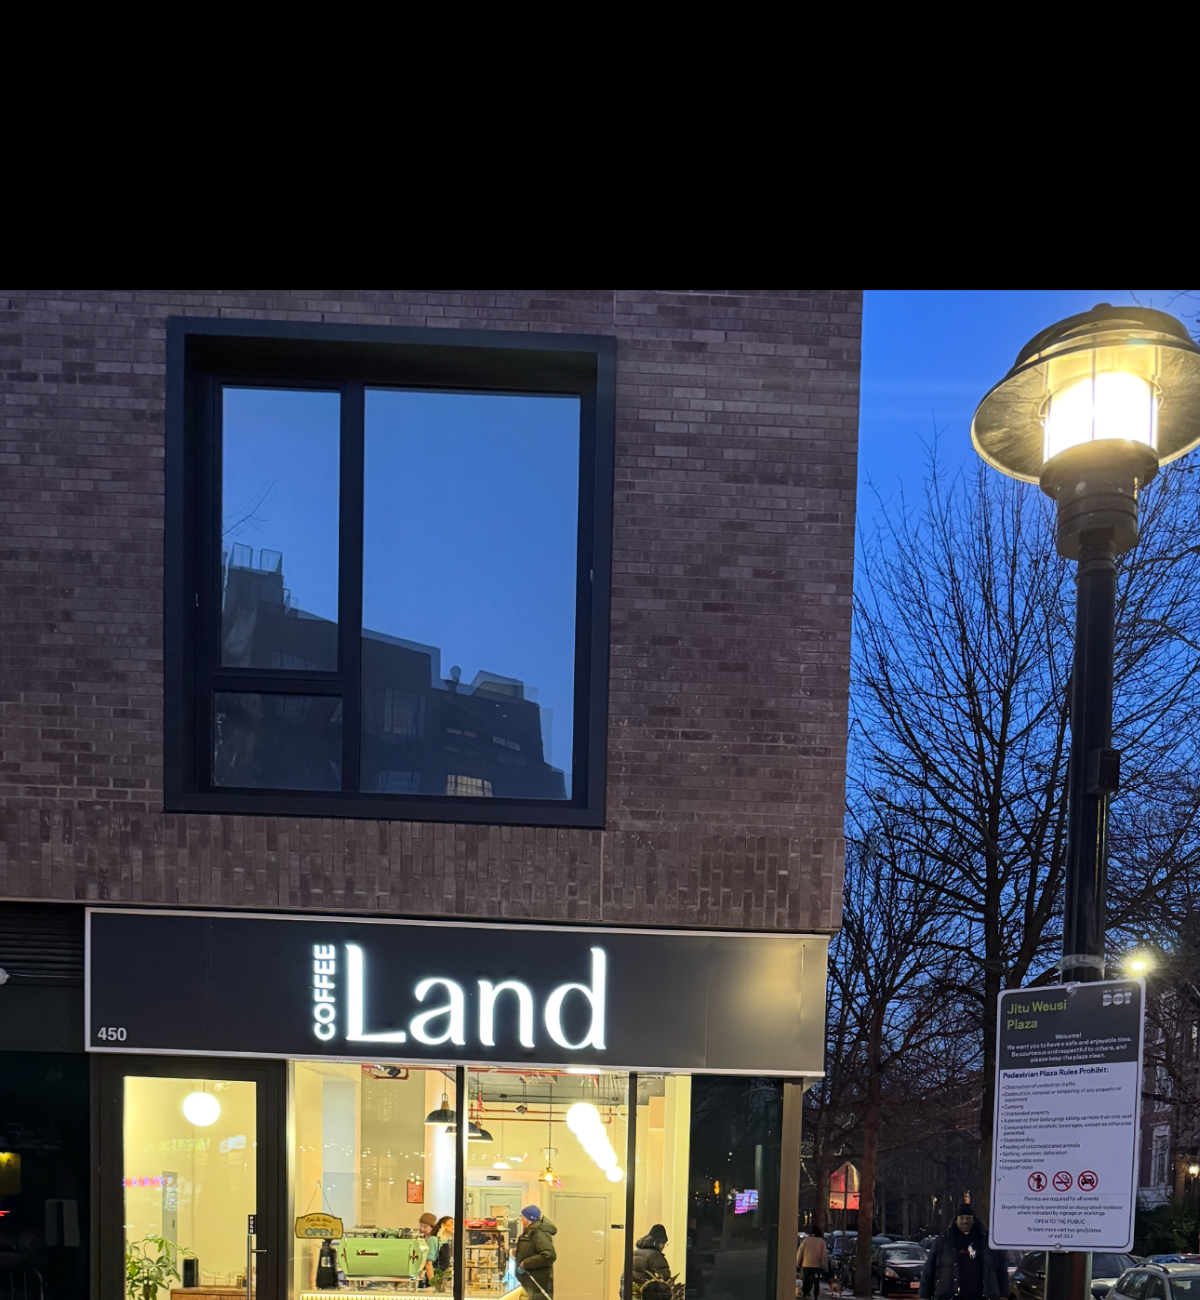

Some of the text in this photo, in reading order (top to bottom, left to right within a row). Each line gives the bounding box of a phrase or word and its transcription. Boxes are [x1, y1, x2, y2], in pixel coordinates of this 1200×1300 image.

[313, 944, 336, 1041] COFFEE
[345, 943, 606, 1050] Land
[1103, 992, 1132, 1007] DOT
[1007, 999, 1067, 1015] Jitu Weusi
[1007, 1019, 1038, 1030] Plaza
[97, 1027, 127, 1041] 450
[1090, 1037, 1117, 1045] enjoyable
[1058, 1046, 1087, 1054] respectful
[1073, 1053, 1088, 1061] plaza
[1003, 1071, 1038, 1079] Pedestrian
[1040, 1069, 1058, 1077] Plaza
[1079, 1066, 1109, 1075] Prohibit:
[304, 1228, 334, 1237] OPEN
